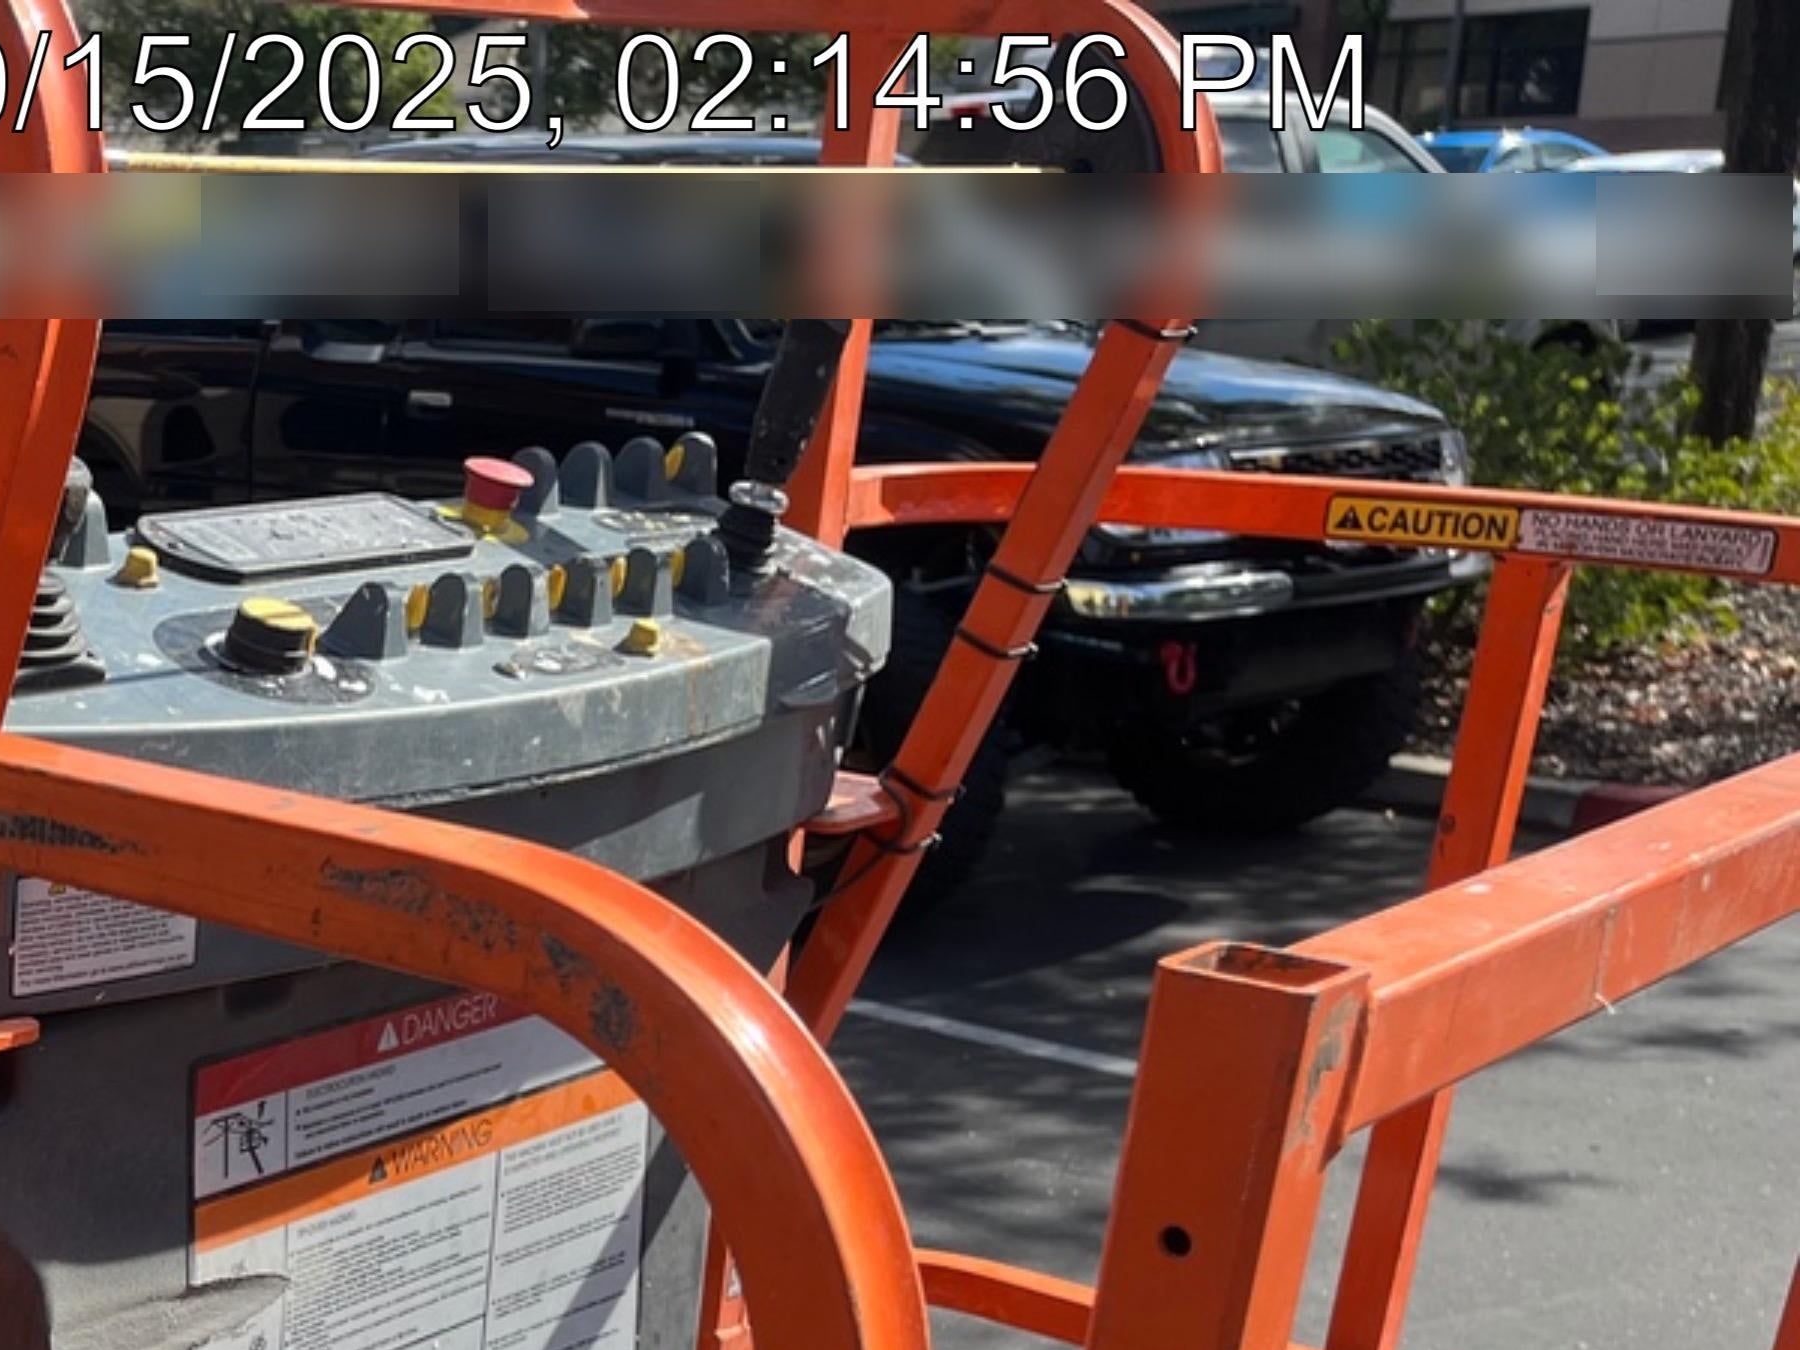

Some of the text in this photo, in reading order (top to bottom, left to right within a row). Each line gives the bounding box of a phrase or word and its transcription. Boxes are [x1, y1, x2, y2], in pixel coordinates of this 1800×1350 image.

[1366, 506, 1509, 541] CAUTION
[1532, 511, 1560, 529] NO
[1565, 514, 1630, 534] HANDS
[1670, 522, 1761, 546] LANYARD
[402, 994, 498, 1046] DANGER
[390, 1118, 493, 1175] WARNING
